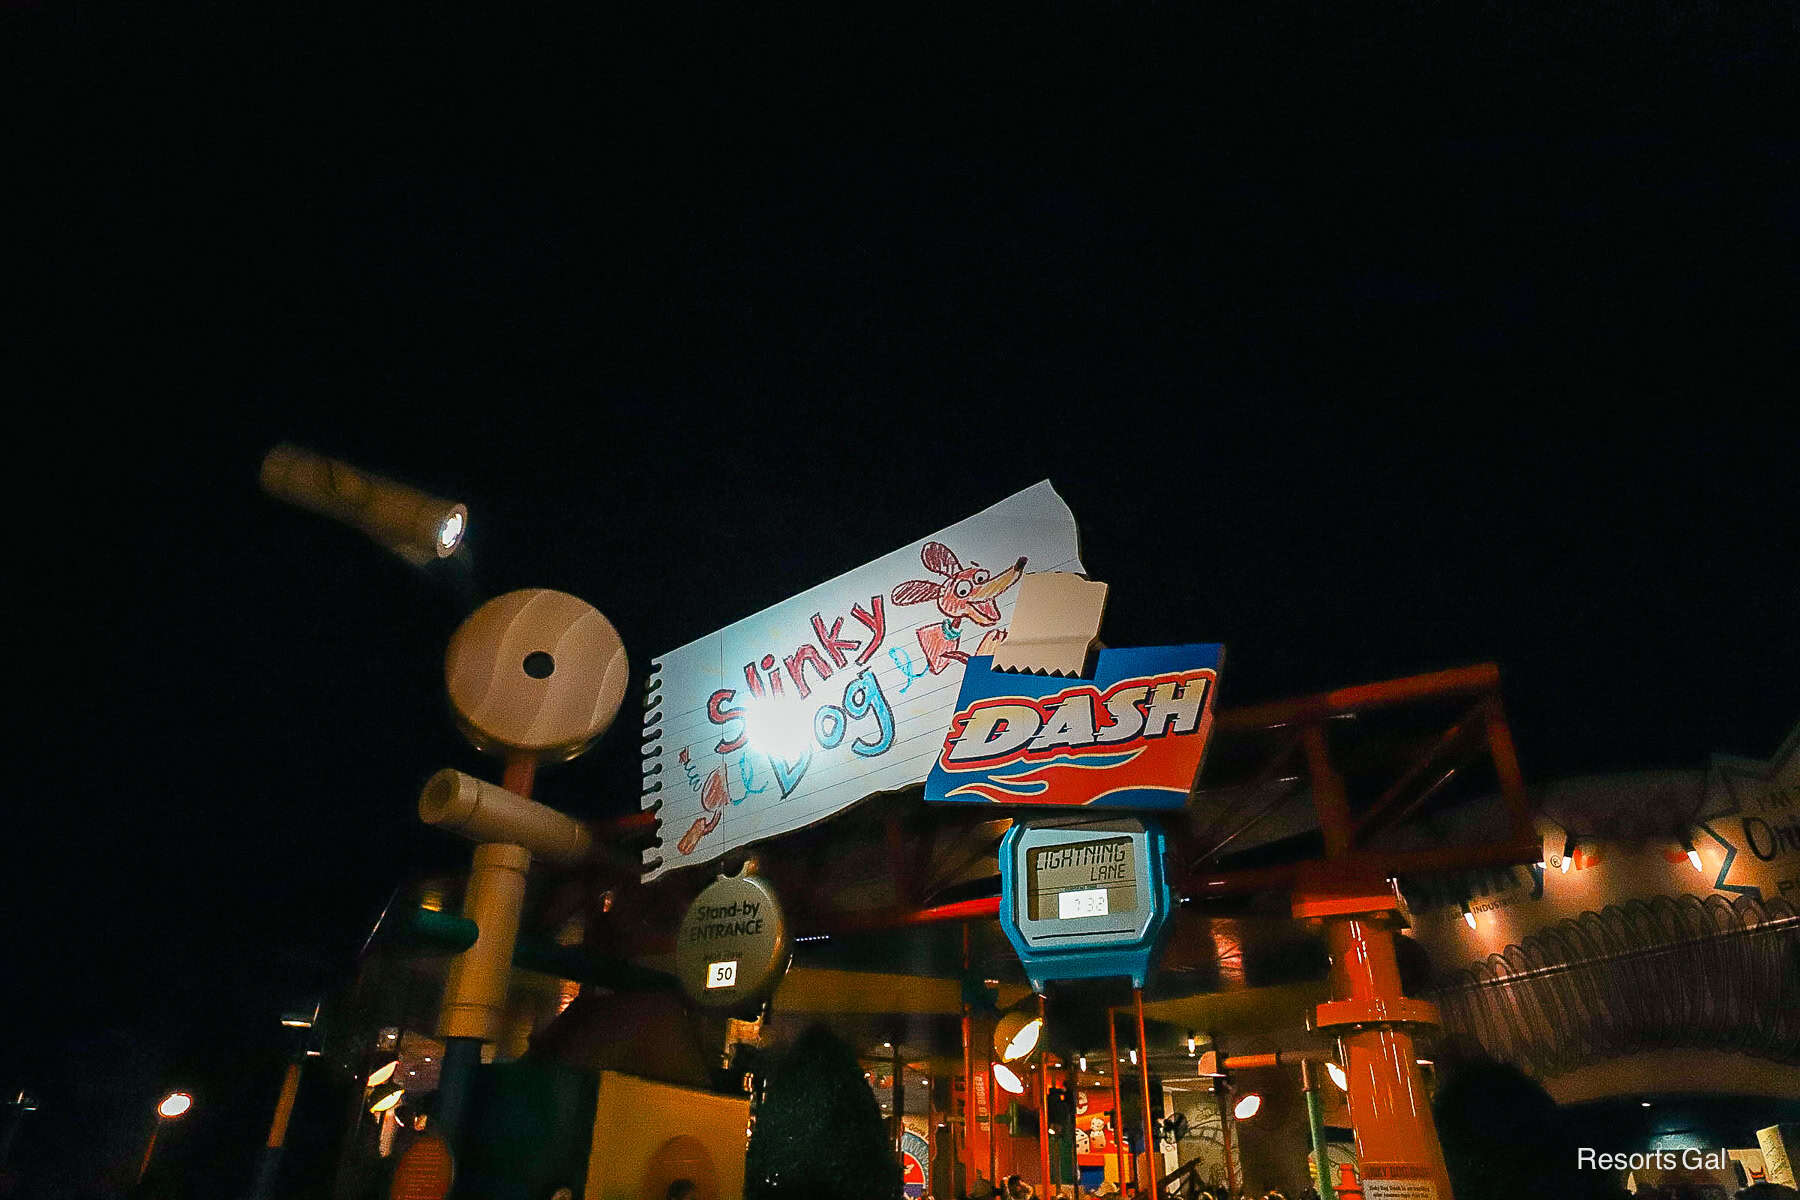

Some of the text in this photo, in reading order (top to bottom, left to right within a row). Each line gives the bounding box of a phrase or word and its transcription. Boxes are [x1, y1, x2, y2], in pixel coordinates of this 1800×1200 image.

[706, 594, 887, 754] Slinky
[949, 677, 1212, 762] DASH
[1035, 842, 1126, 871] LIGHTNING
[1090, 863, 1126, 882] LANE
[697, 900, 760, 921] Stand-by
[689, 919, 764, 942] ENTRANCE
[716, 966, 733, 981] 50
